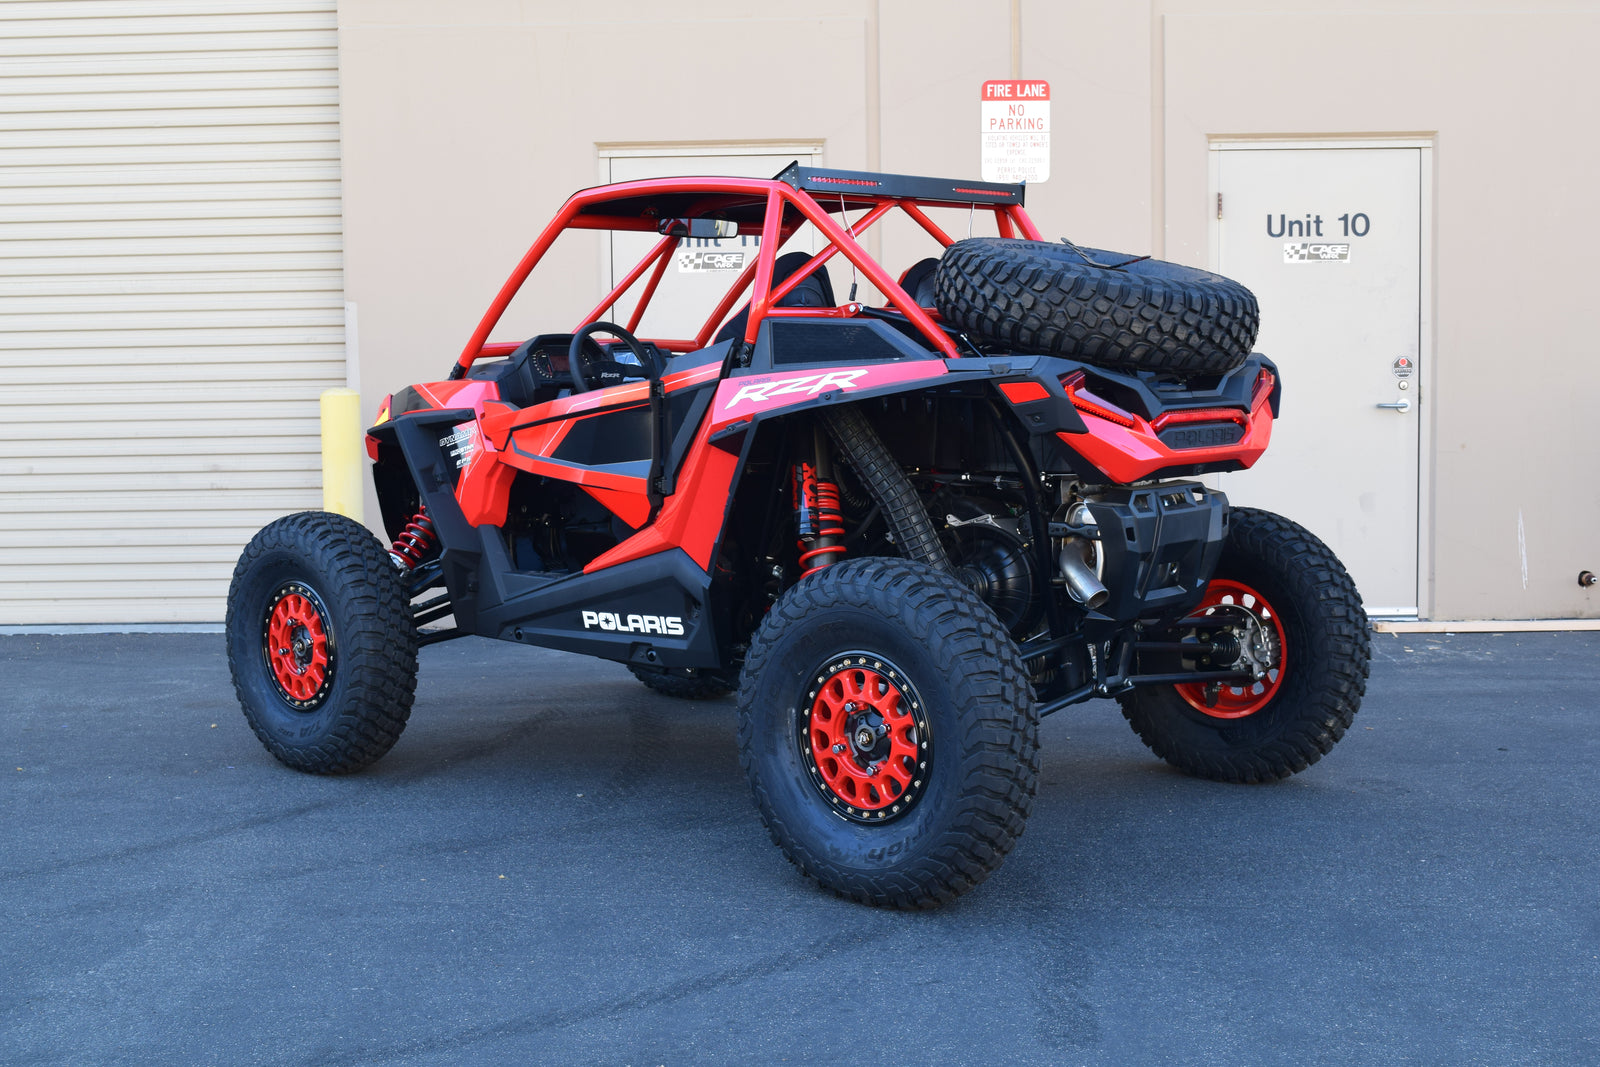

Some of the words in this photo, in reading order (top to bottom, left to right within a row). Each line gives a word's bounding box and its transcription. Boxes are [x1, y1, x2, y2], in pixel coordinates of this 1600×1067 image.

[987, 84, 1012, 97] FIRE
[1017, 84, 1046, 97] LANE
[1008, 104, 1025, 116] NO
[990, 118, 1044, 130] PARKING
[1267, 214, 1323, 238] Unit
[1338, 213, 1370, 237] 10
[1309, 245, 1349, 254] CAGE
[704, 254, 743, 263] CAGE
[738, 377, 771, 387] POLARIS
[724, 369, 869, 410] RZR
[1174, 428, 1235, 446] POLARIS
[582, 611, 684, 635] POLARIS
